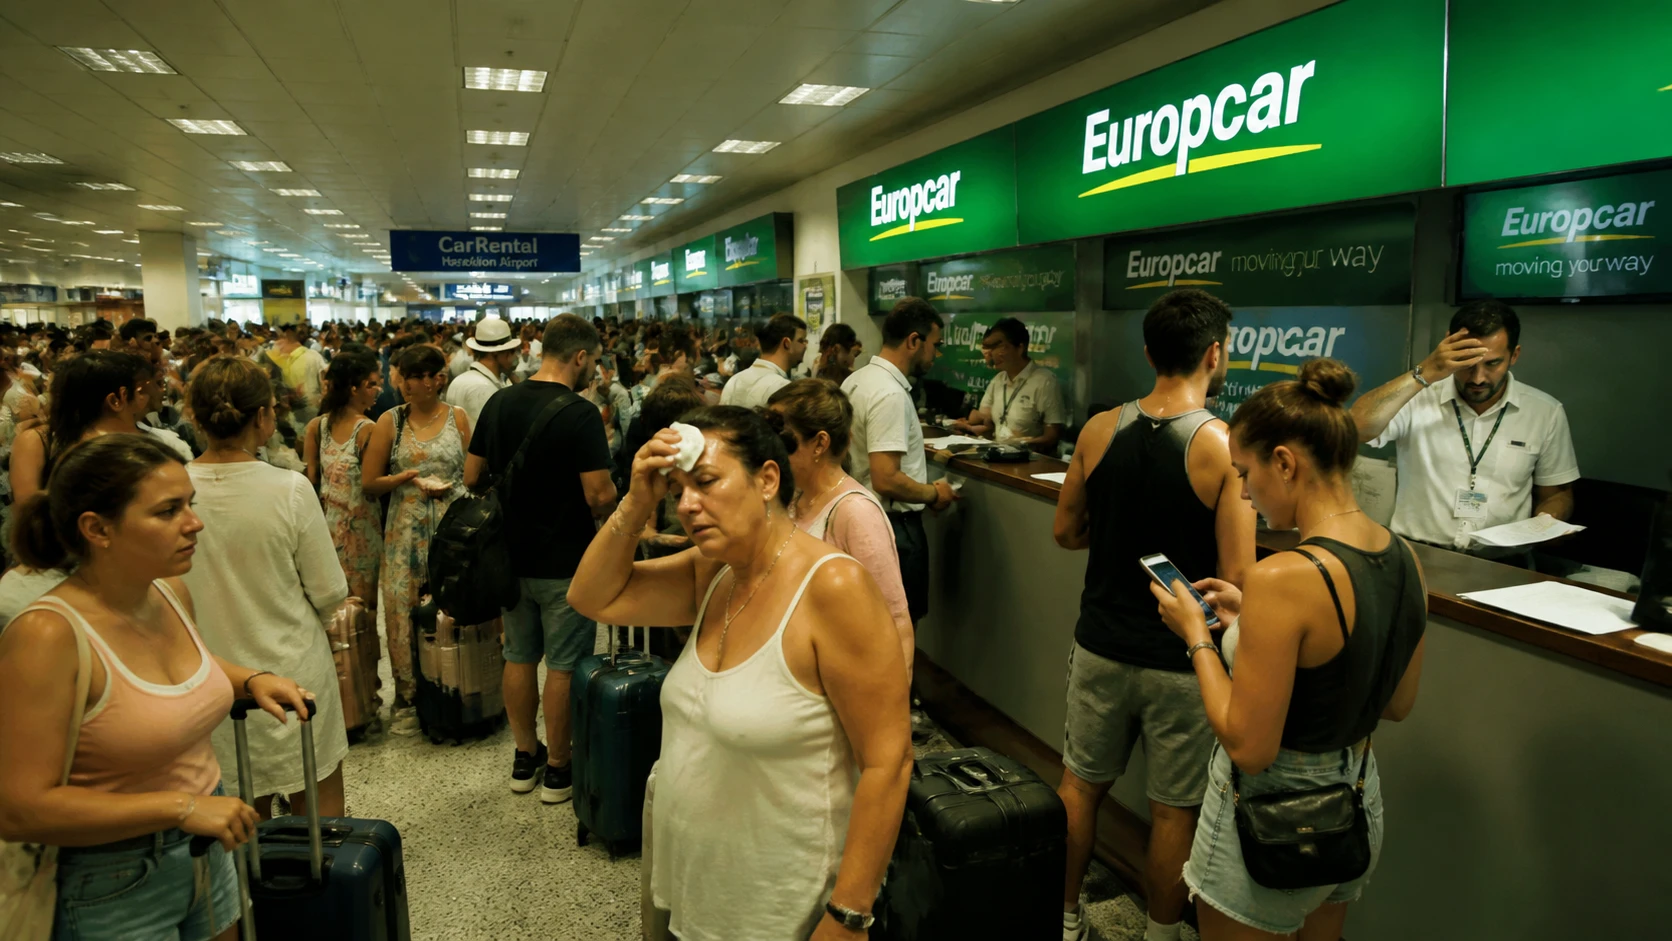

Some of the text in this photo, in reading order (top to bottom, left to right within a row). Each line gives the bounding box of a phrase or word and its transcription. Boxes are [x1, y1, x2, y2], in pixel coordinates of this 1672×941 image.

[1082, 59, 1316, 176] Europcar
[870, 170, 961, 232] Europcar
[1501, 200, 1656, 243] Europcar
[1126, 250, 1222, 287] Europcar
[1329, 245, 1384, 273] way
[1495, 255, 1655, 278] moving your way
[1228, 326, 1346, 371] ropcar
